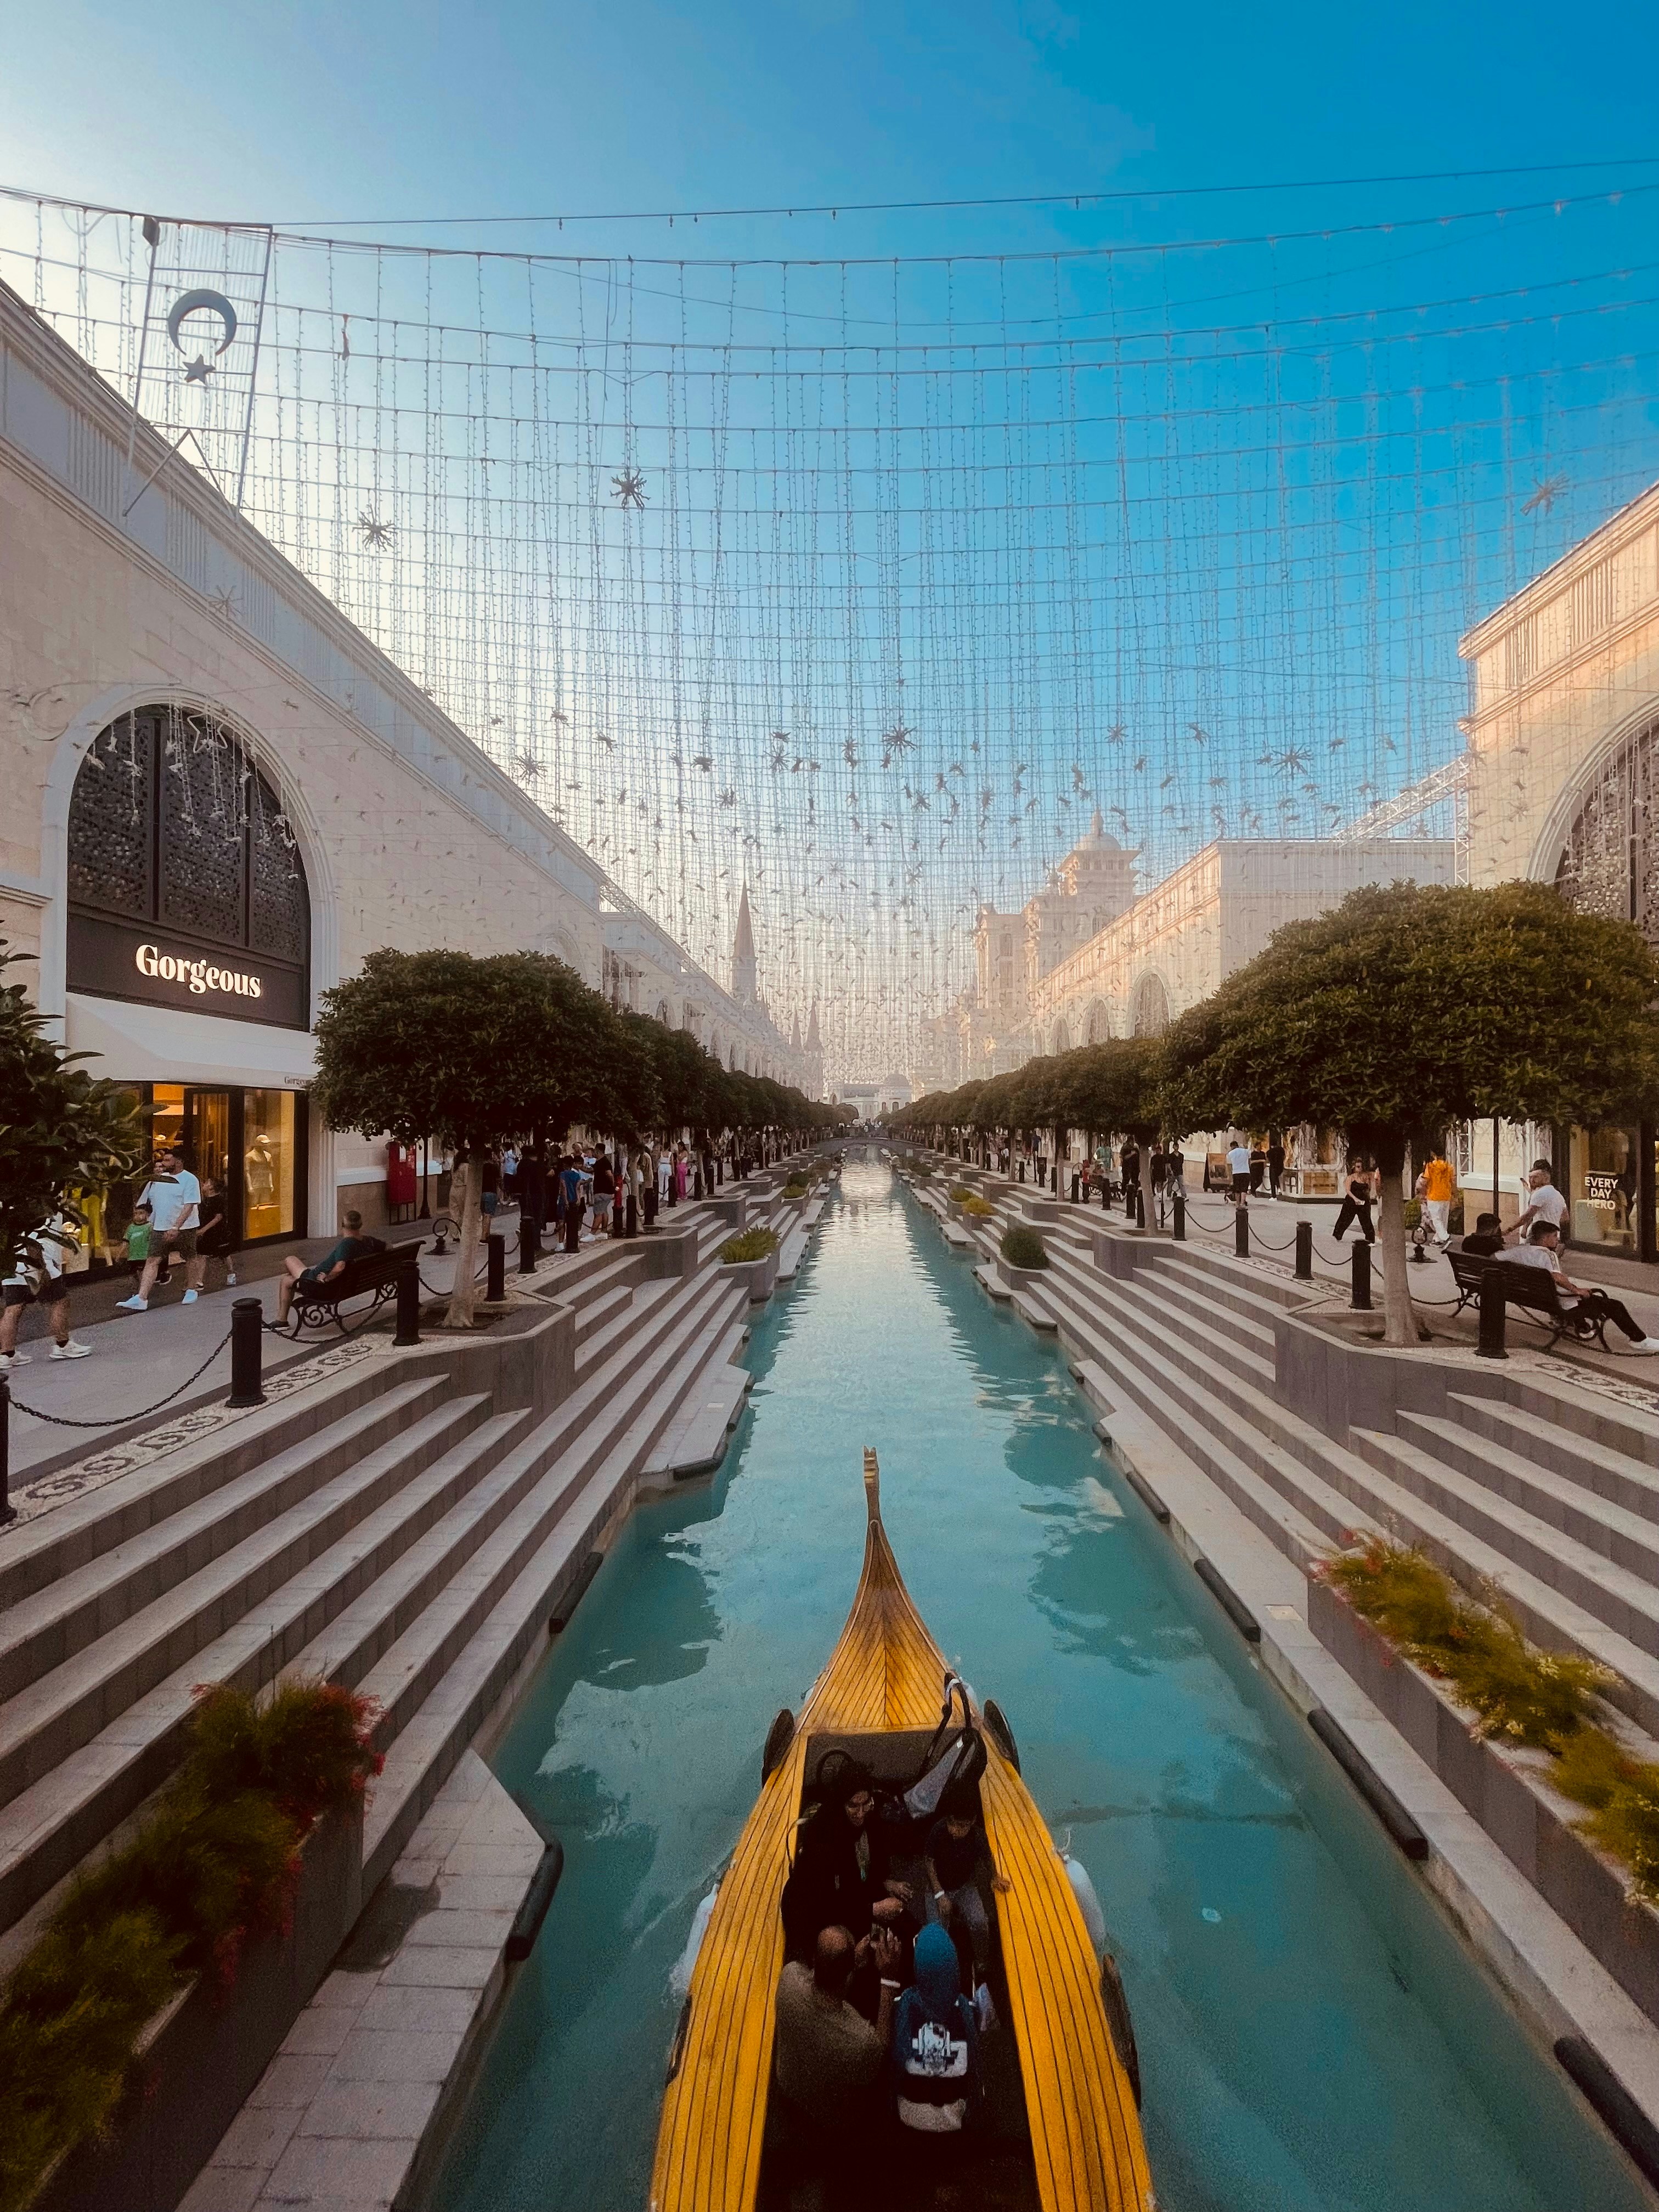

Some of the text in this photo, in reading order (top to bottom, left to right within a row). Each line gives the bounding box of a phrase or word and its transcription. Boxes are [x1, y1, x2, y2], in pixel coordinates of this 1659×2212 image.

[136, 944, 262, 998] Gorgeous
[1584, 1176, 1618, 1189] EVERY
[1590, 1188, 1612, 1199] DAY
[1587, 1198, 1616, 1210] HERO
